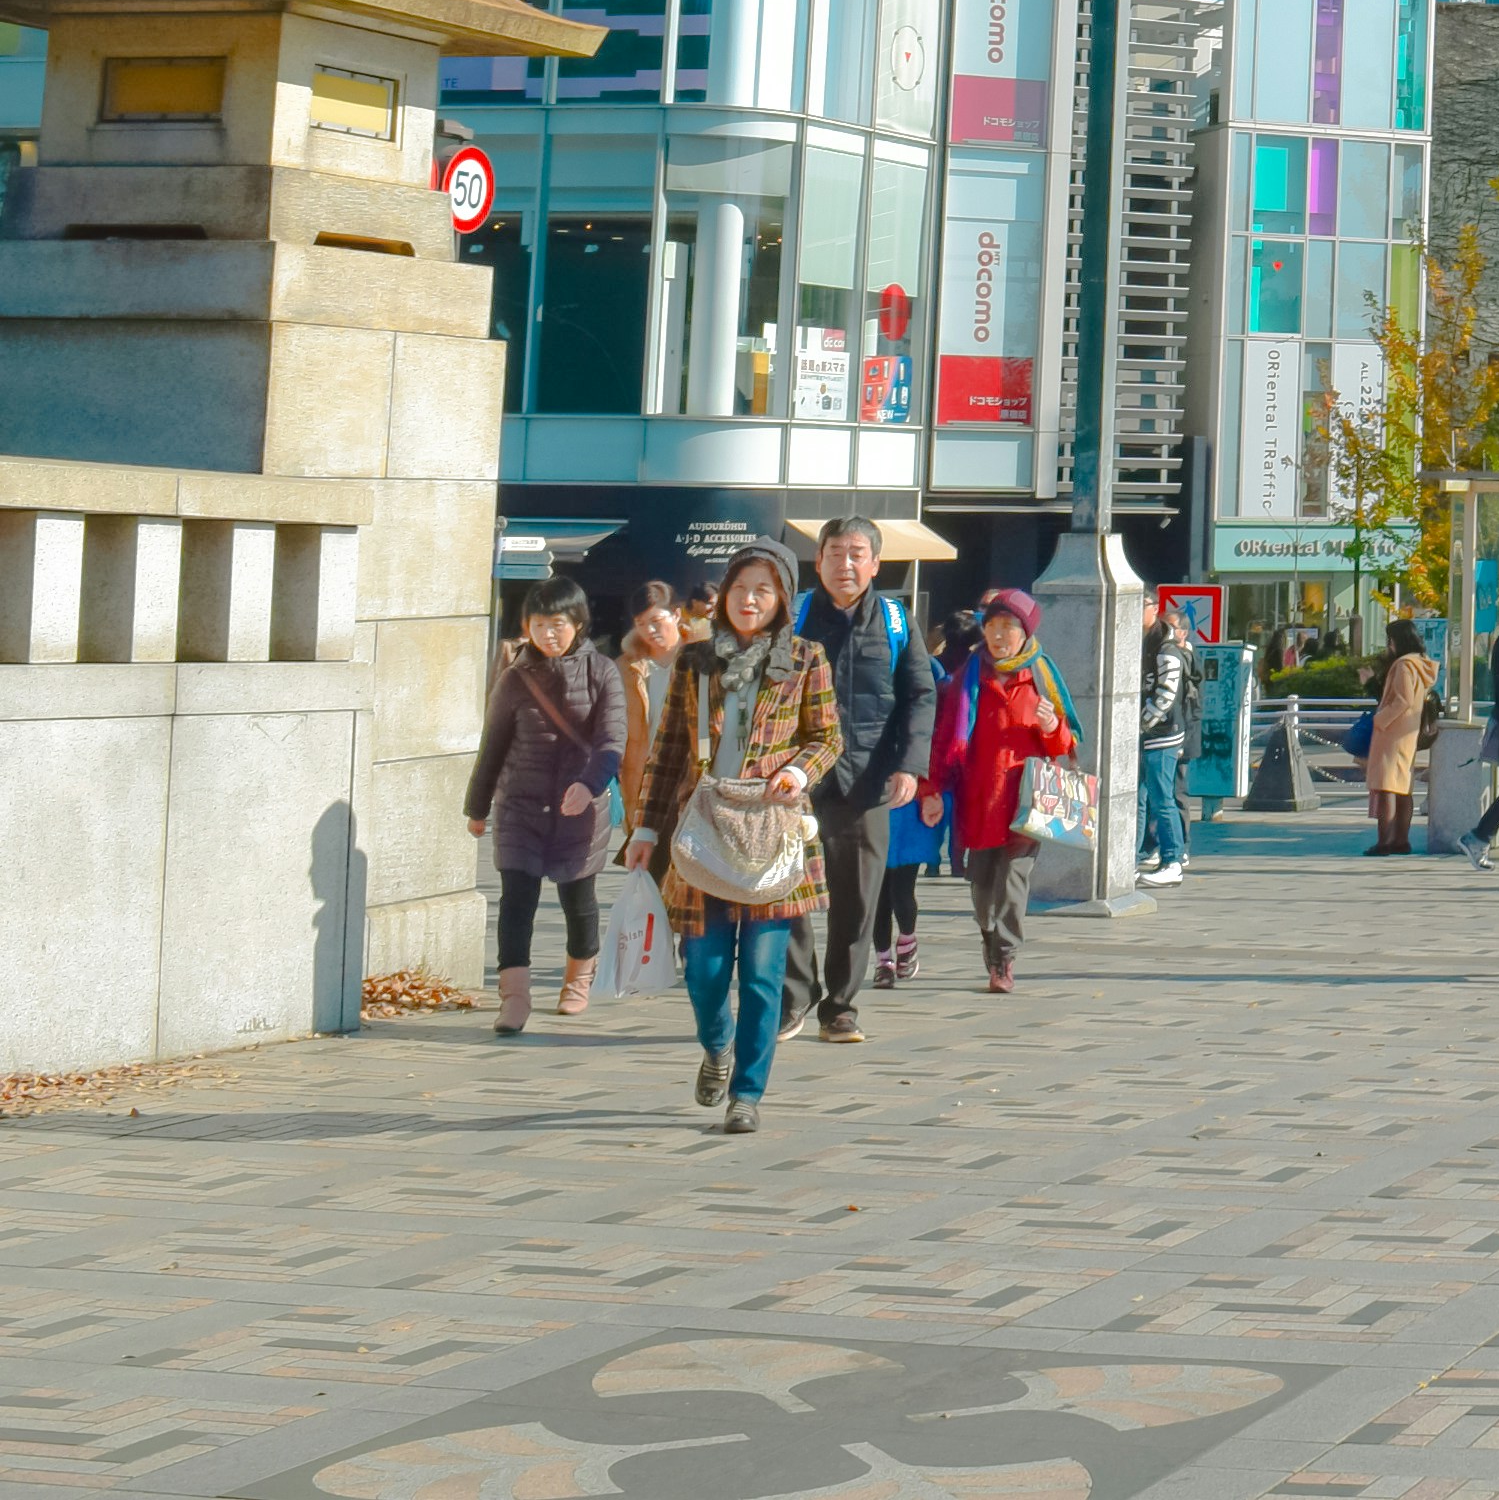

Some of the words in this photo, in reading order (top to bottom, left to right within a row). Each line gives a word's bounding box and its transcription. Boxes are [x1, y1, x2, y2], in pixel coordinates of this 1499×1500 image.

[454, 170, 483, 209] 50
[973, 231, 1001, 343] docomo
[969, 396, 1028, 407] ドコモショップ
